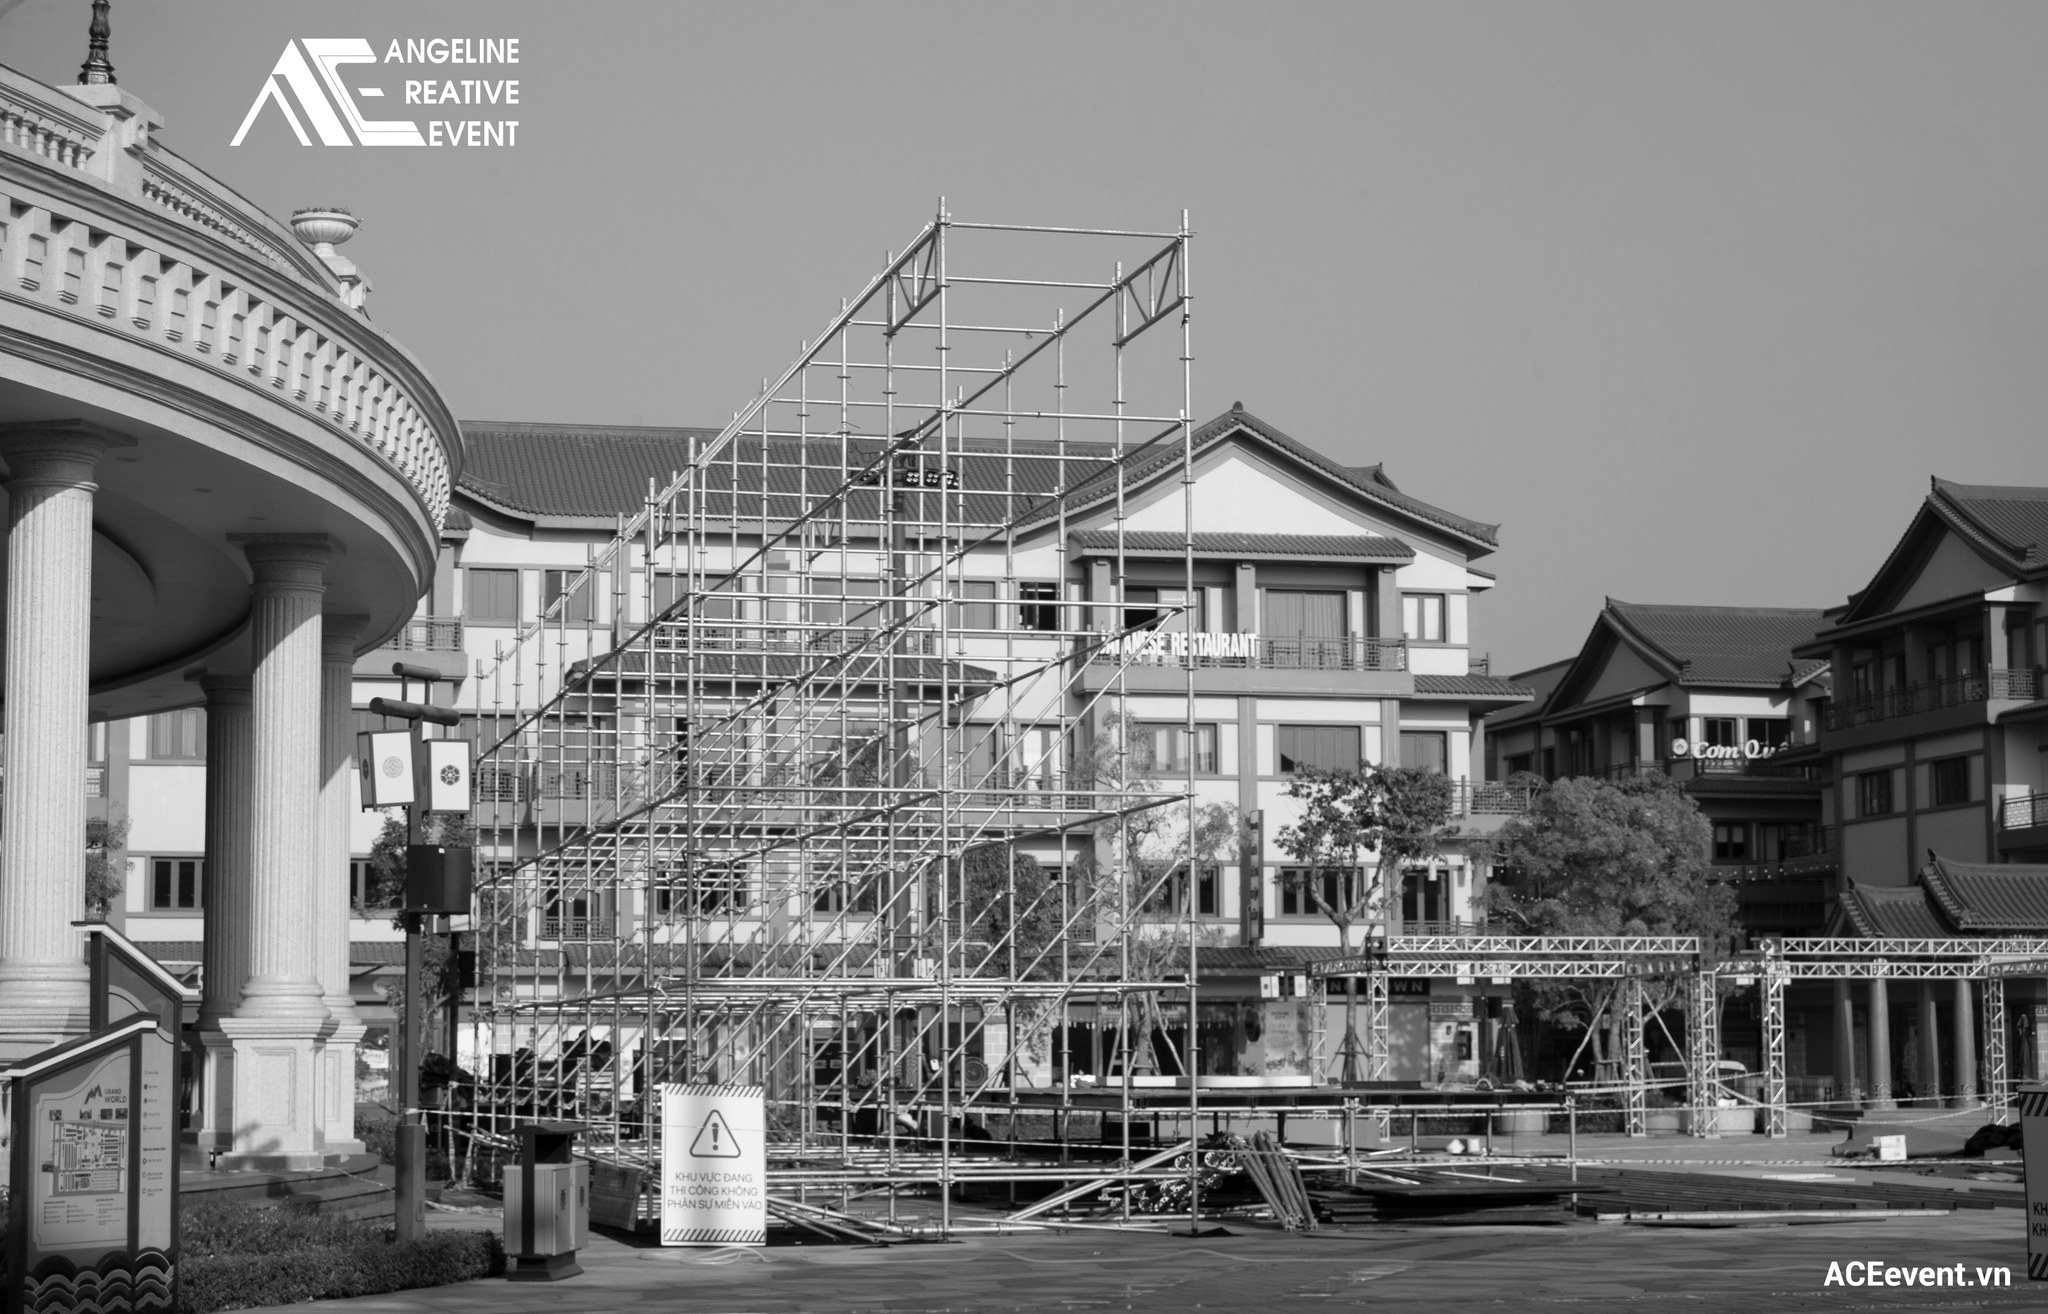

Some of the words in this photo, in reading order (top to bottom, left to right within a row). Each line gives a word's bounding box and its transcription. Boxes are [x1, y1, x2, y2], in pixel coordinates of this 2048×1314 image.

[1170, 631, 1257, 657] RESTAURANT
[105, 1095, 127, 1104] WORLD
[675, 1172, 698, 1182] KHU
[723, 1173, 753, 1183] ĐANG
[670, 1186, 687, 1195] THI
[688, 1184, 719, 1196] CÔNG
[721, 1185, 758, 1197] KHÔNG
[741, 1200, 763, 1210] VÀO
[2033, 1201, 2048, 1216] KH
[2032, 1222, 2048, 1237] KH
